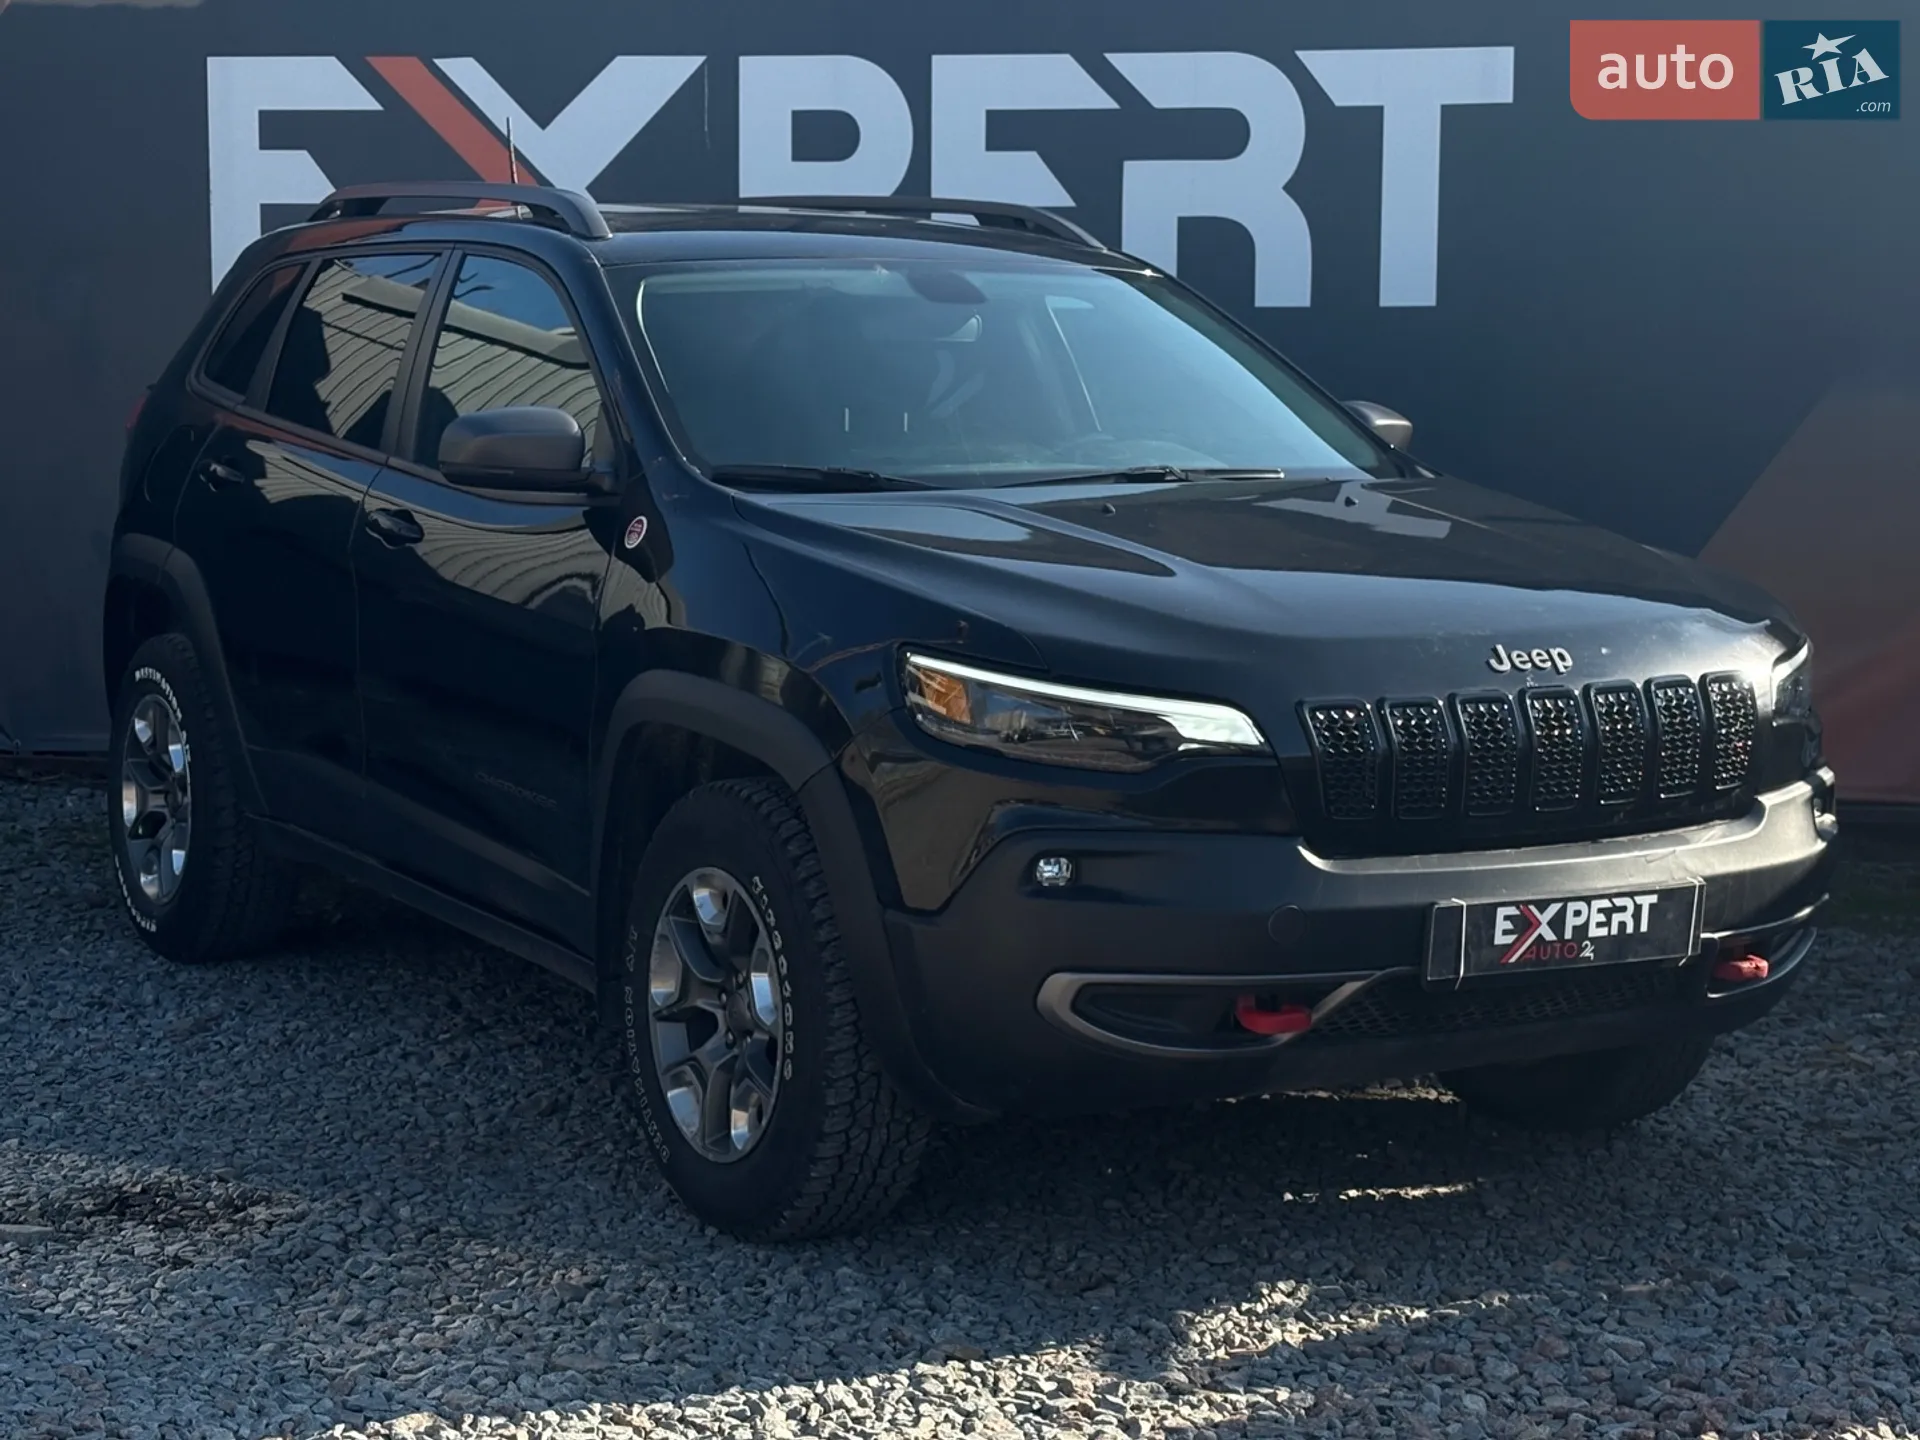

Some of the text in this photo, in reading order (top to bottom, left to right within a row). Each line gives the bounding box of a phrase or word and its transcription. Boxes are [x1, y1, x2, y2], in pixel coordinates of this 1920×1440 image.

[207, 46, 1515, 307] EXPERT
[1488, 643, 1574, 673] Jeep
[1493, 894, 1659, 963] EXPERT
[623, 985, 671, 1164] DESTINATION
